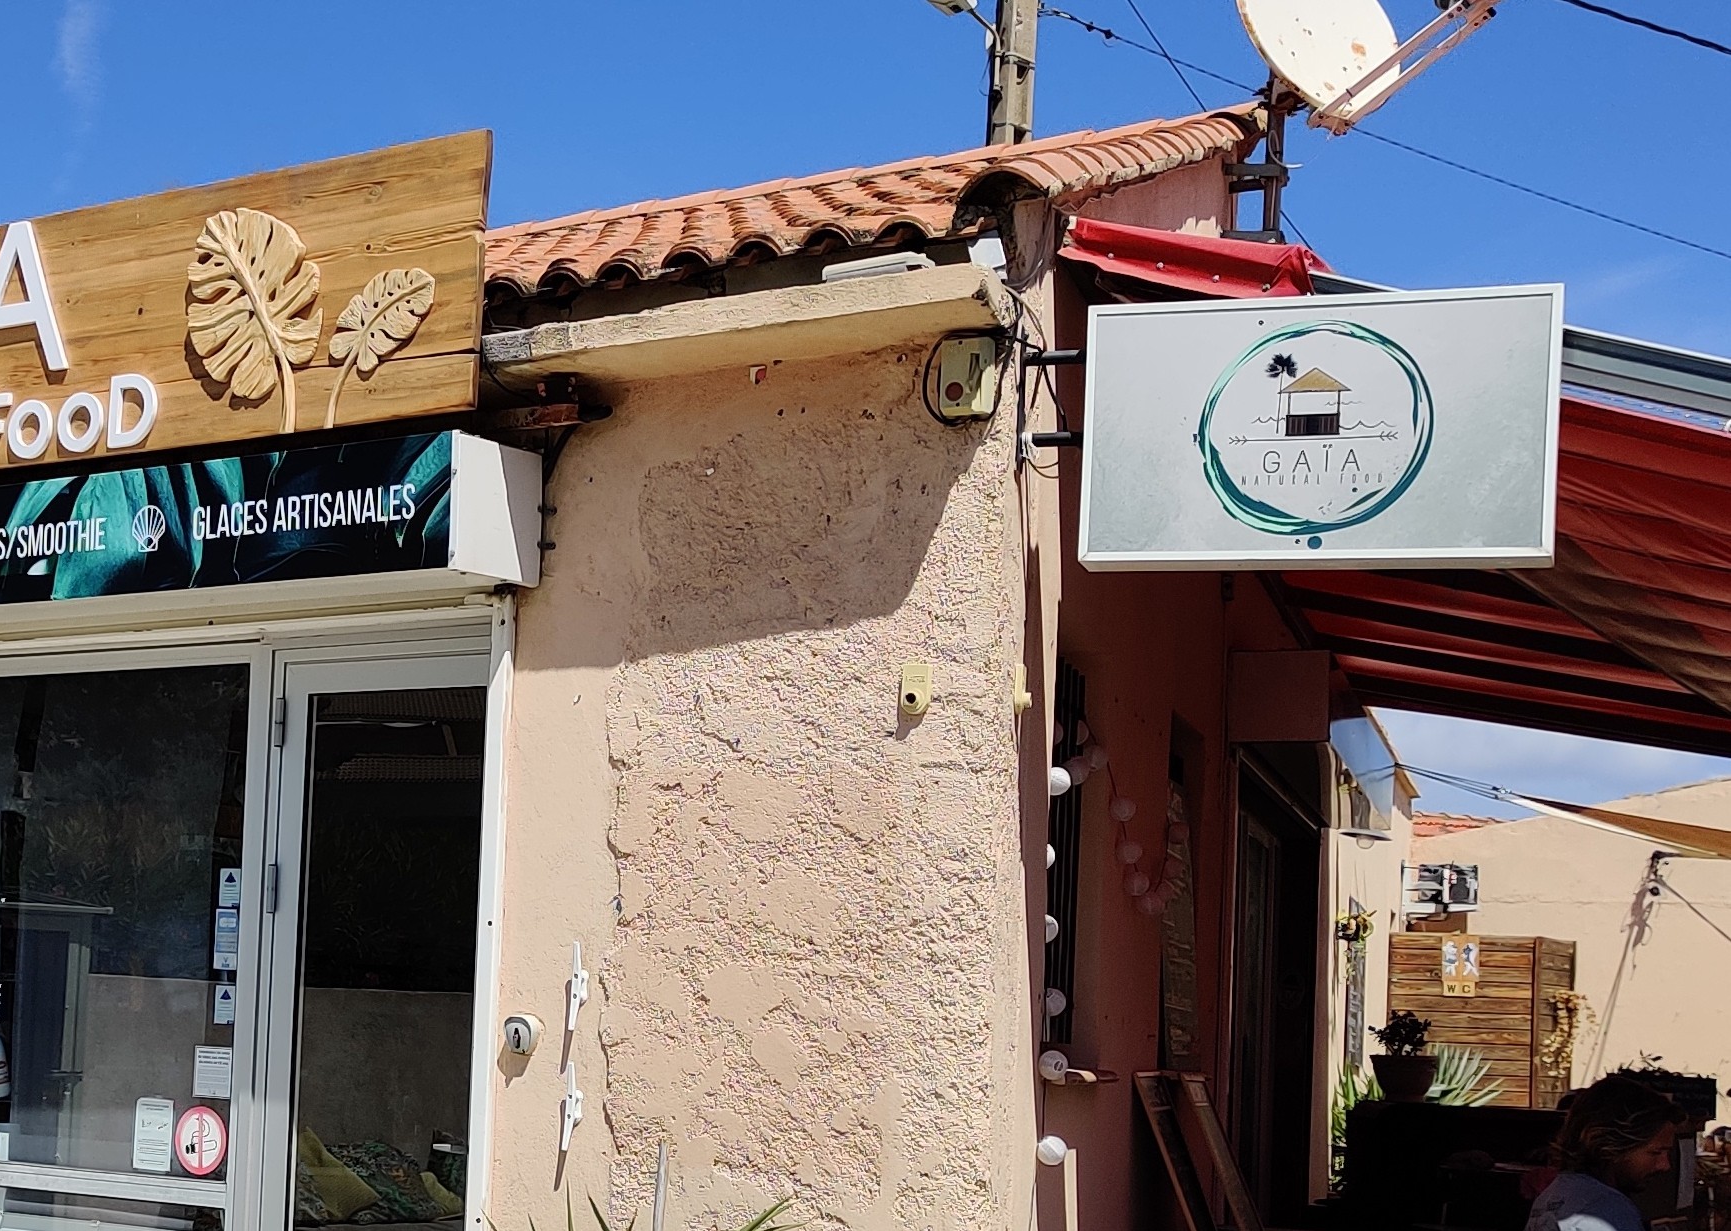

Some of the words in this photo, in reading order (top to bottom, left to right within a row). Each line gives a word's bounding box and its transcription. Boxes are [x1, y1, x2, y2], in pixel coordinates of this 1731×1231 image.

[1241, 474, 1320, 486] NATURAL
[1339, 472, 1383, 484] FOOD
[192, 499, 268, 541] GLACES
[272, 483, 416, 533] ARTISANALES
